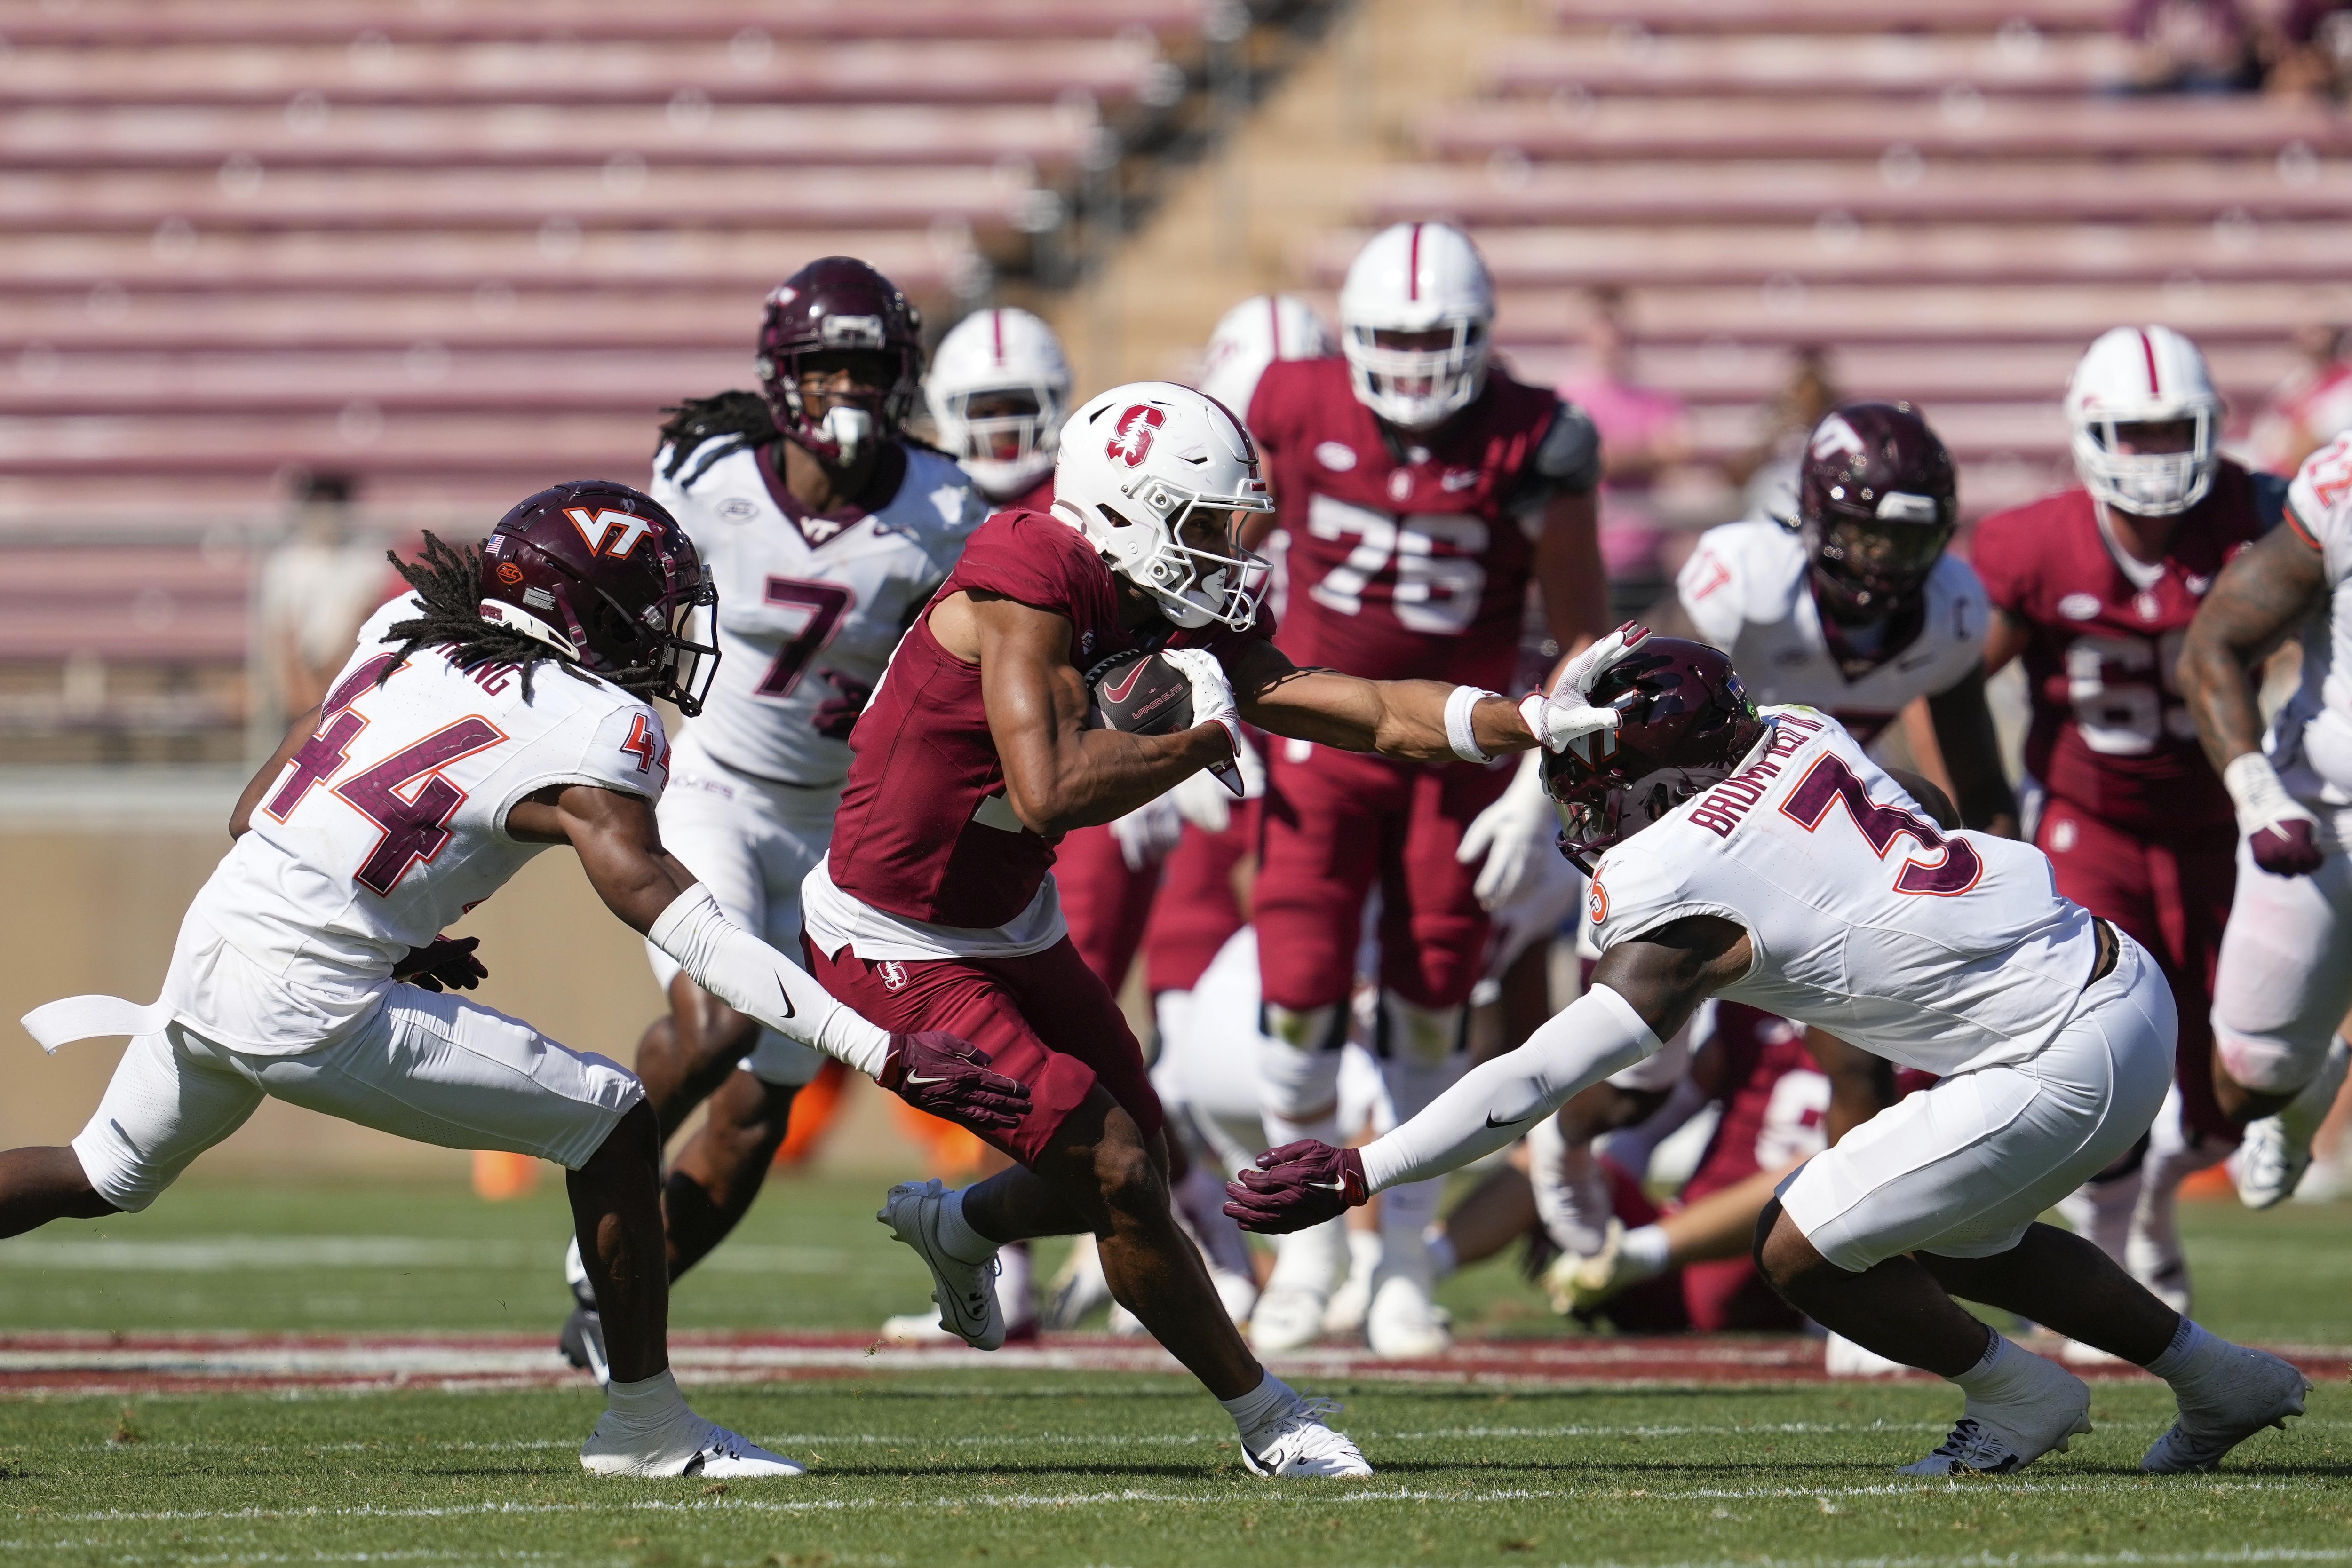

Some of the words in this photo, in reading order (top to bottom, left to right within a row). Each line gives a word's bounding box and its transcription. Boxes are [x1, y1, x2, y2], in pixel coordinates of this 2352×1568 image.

[563, 507, 666, 560] VT
[1308, 492, 1490, 635] 76
[755, 575, 855, 697] 7
[1132, 697, 1163, 720] VAPOR
[1161, 683, 1184, 702] ELITE
[262, 652, 509, 898] 44
[1778, 750, 1982, 897] 3
